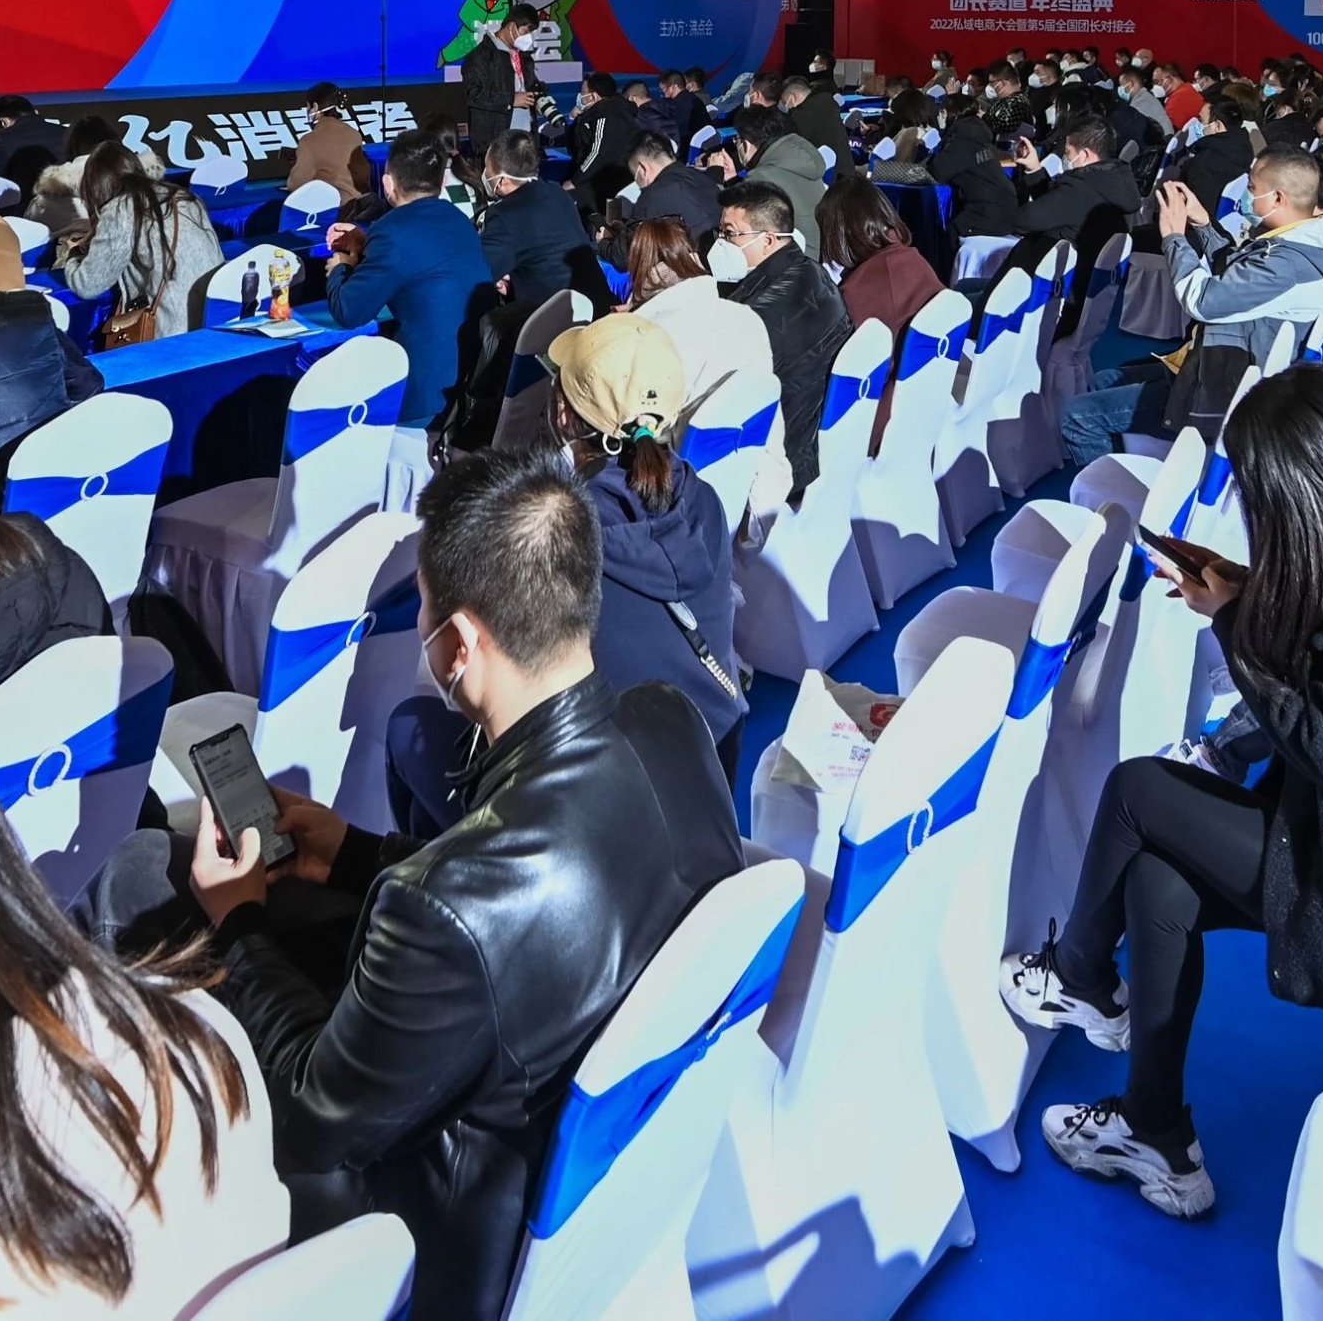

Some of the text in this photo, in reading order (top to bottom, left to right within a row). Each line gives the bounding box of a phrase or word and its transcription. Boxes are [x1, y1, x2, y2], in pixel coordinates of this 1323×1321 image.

[929, 18, 1136, 34] 2022私域电商大会暨第5届全国团长对接会
